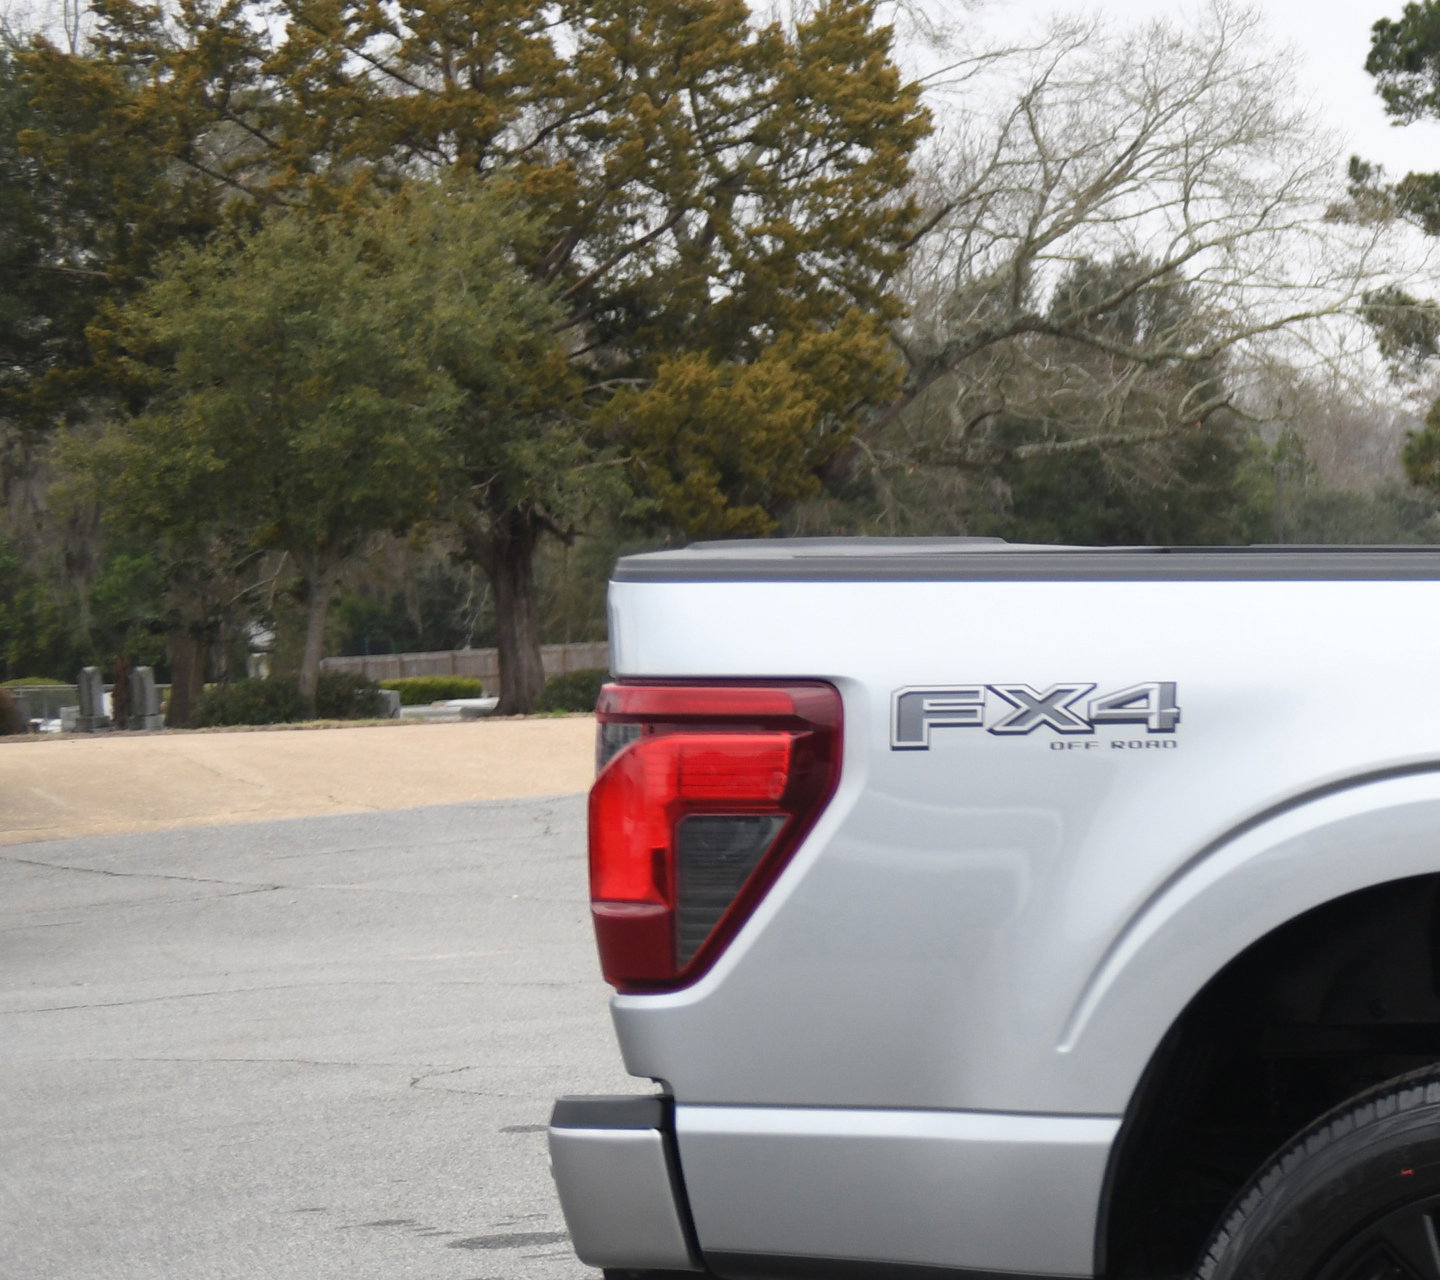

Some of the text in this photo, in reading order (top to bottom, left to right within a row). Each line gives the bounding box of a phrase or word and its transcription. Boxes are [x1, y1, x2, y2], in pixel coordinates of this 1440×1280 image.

[890, 681, 1180, 751] FX4
[1050, 740, 1178, 751] OFF ROAD
